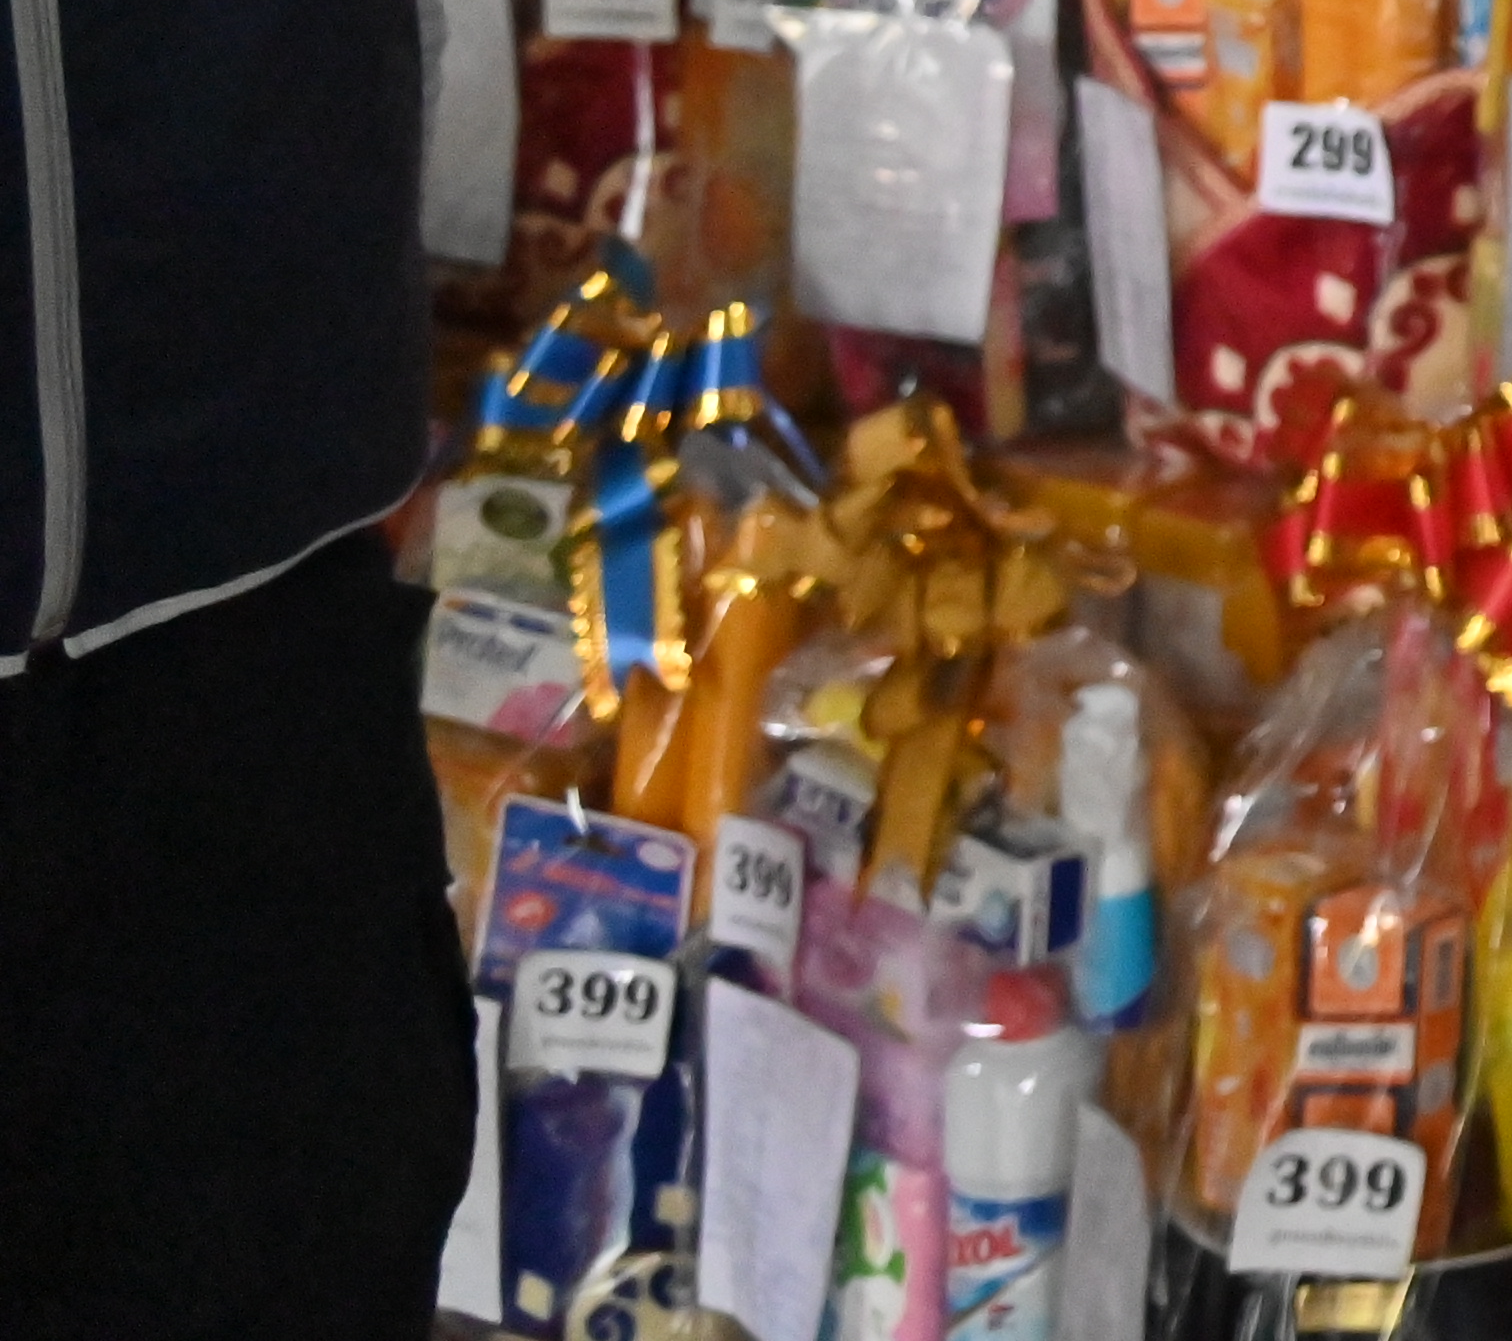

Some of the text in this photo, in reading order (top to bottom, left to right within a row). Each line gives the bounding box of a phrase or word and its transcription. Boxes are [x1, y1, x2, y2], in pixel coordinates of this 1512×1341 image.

[1290, 124, 1376, 178] 299
[533, 966, 660, 1022] 399
[1265, 1153, 1407, 1212] 399
